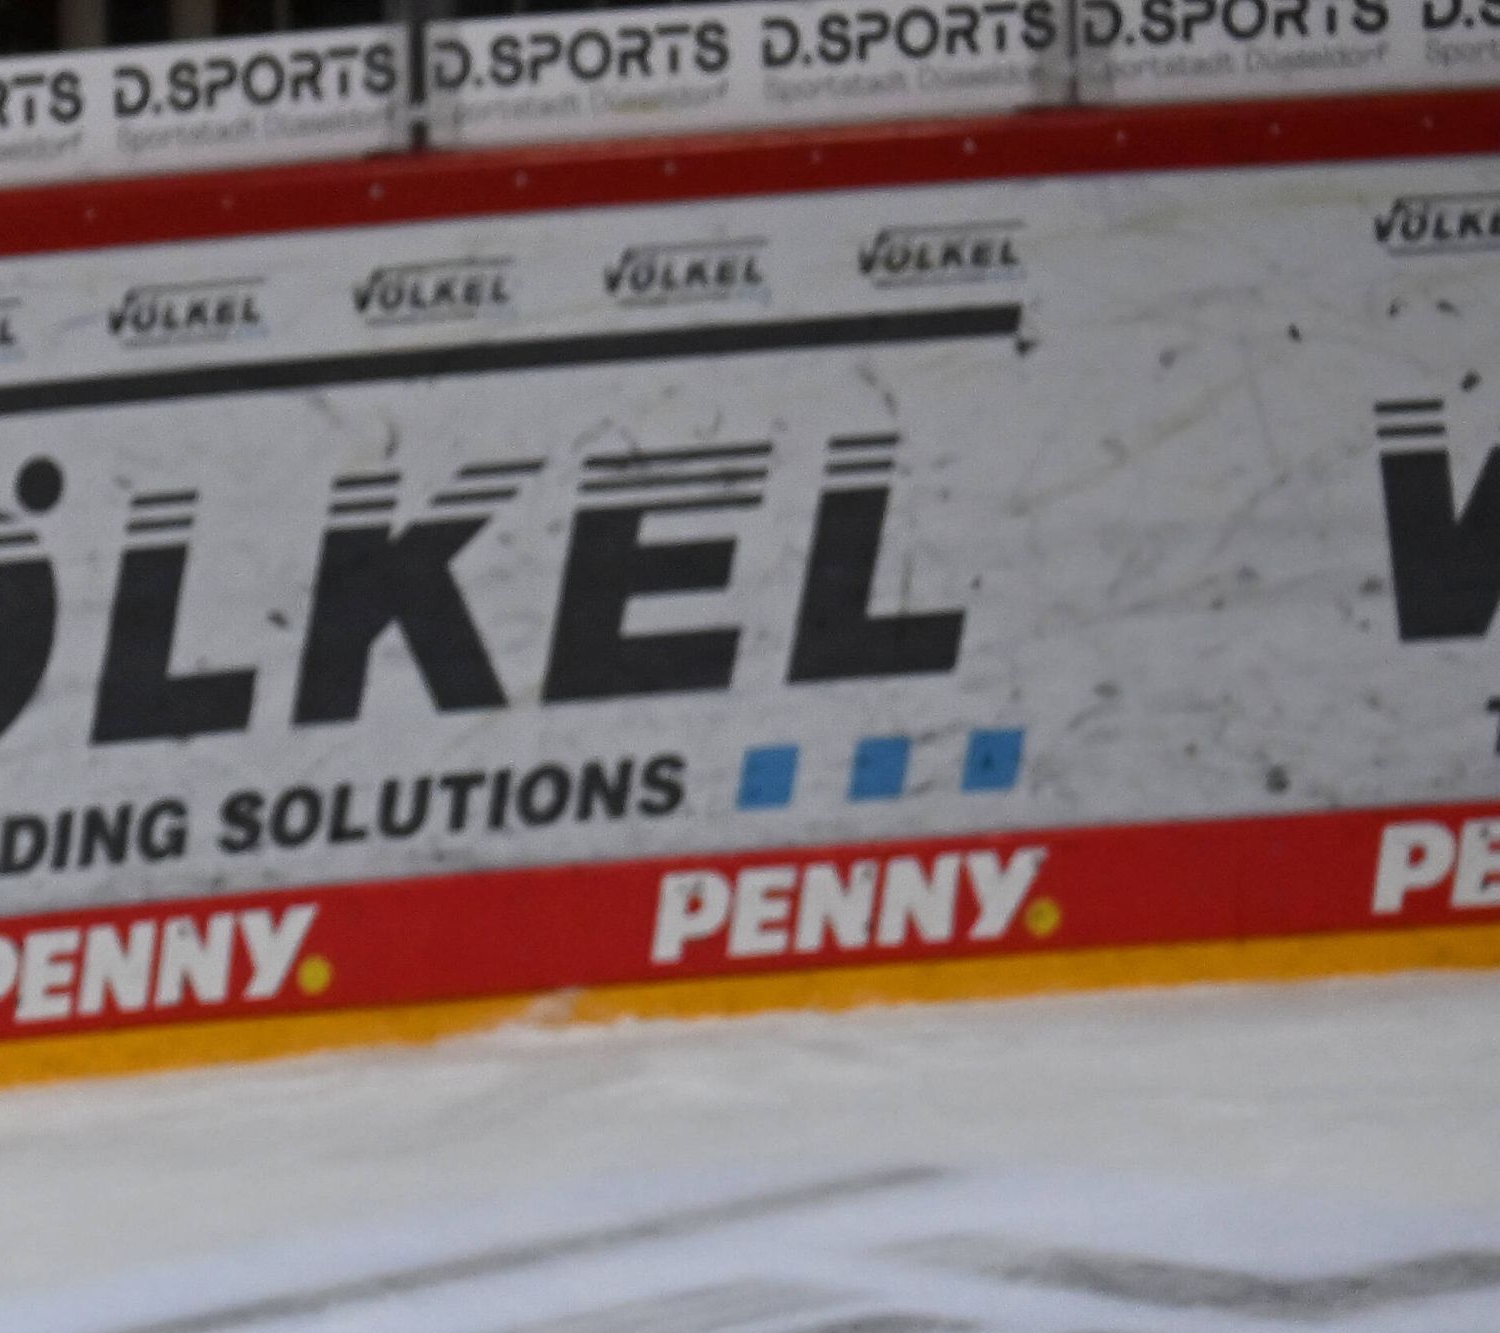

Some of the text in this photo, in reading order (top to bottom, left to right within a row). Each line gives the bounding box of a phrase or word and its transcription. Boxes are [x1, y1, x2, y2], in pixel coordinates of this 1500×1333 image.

[114, 43, 395, 119] D.SPORTS
[434, 4, 1055, 90] D.SPORTS D.SPORTS
[221, 755, 686, 851] SOLUTIONS
